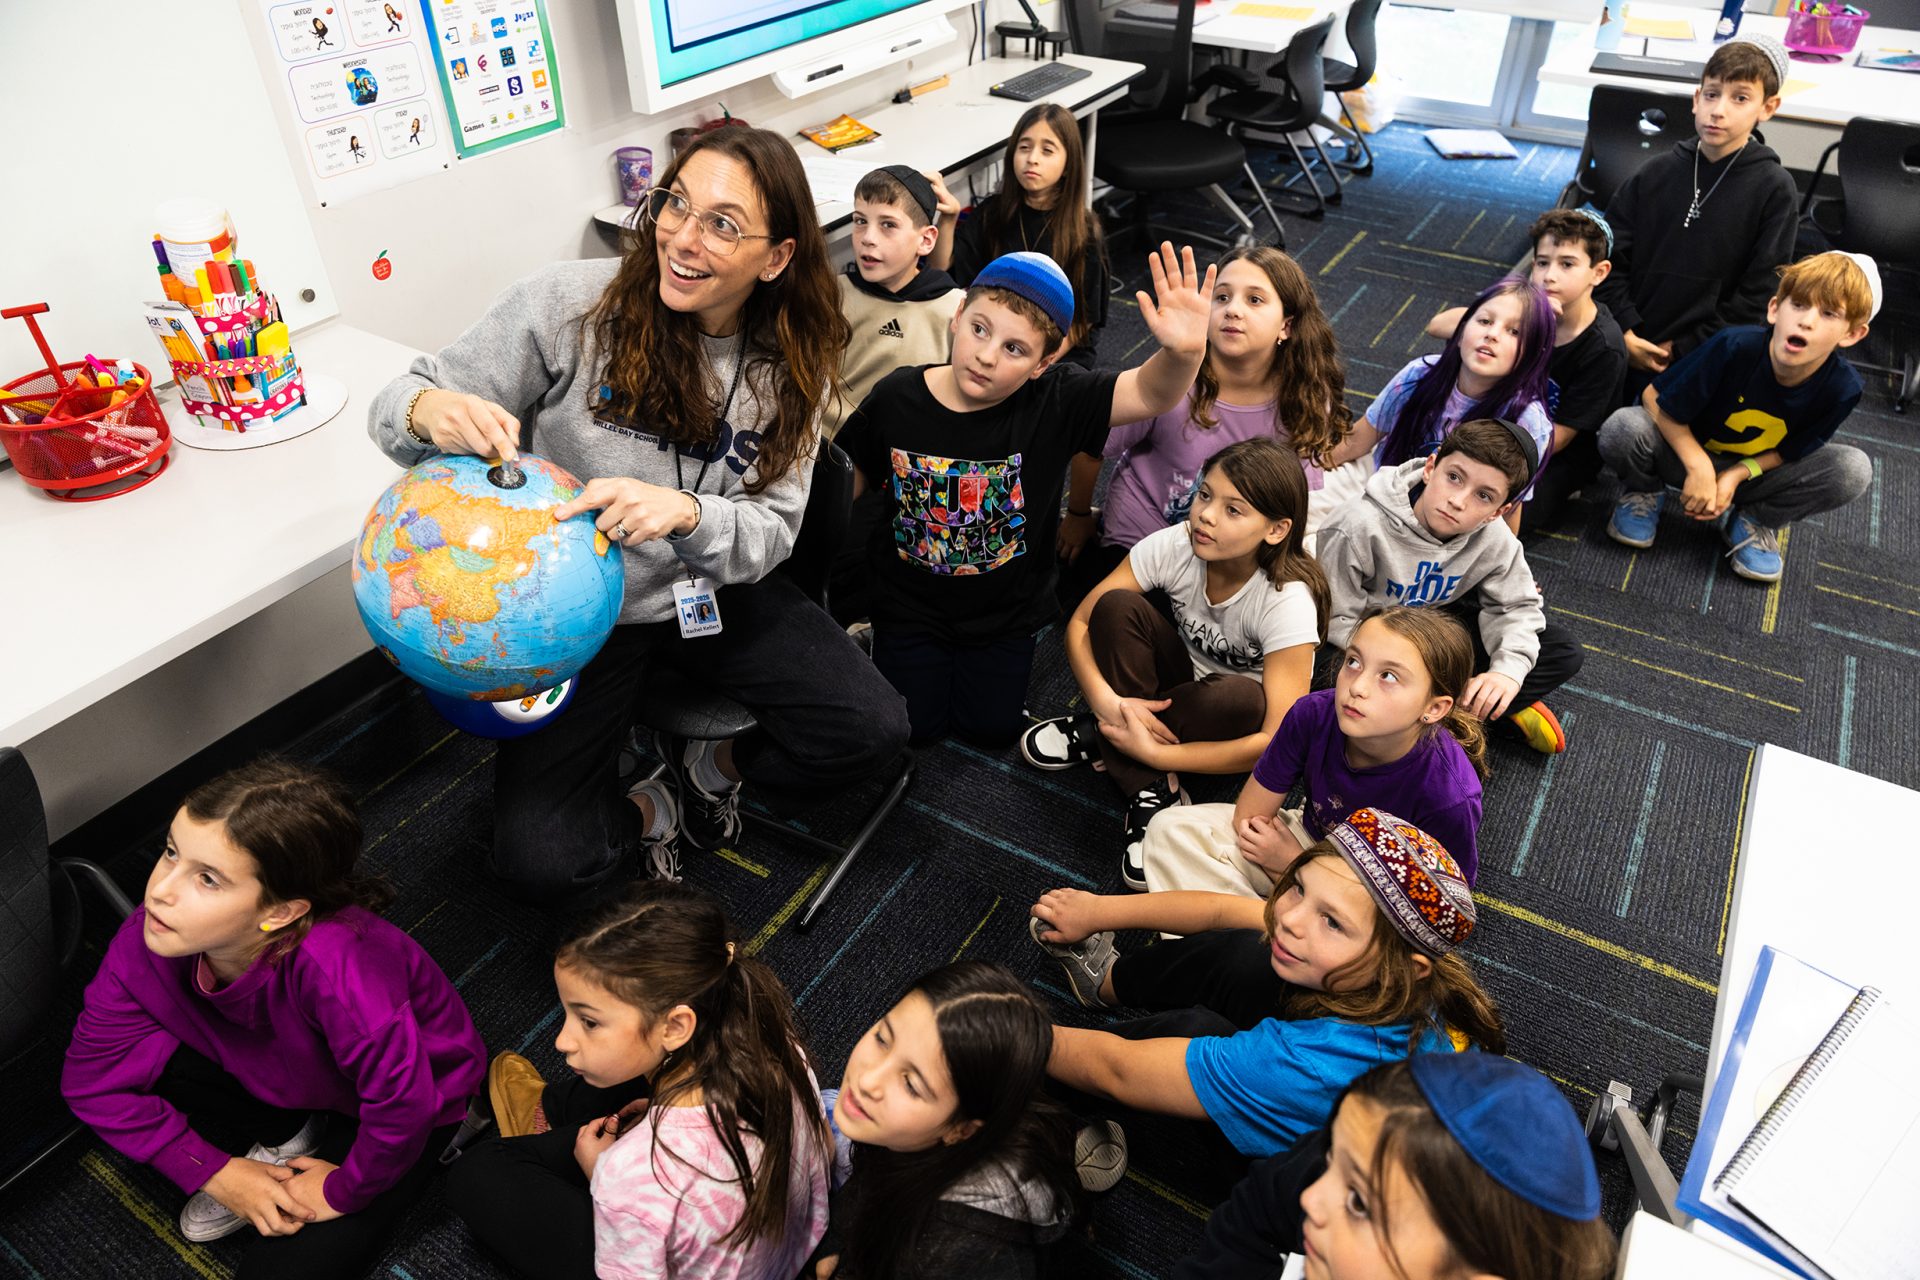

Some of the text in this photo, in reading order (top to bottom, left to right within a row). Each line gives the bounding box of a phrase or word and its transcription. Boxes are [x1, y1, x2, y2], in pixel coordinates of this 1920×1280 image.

[464, 123, 485, 133] Games
[879, 329, 904, 339] adidas
[618, 425, 634, 438] DAY
[1704, 408, 1788, 456] 2
[117, 457, 149, 475] Lakeshore
